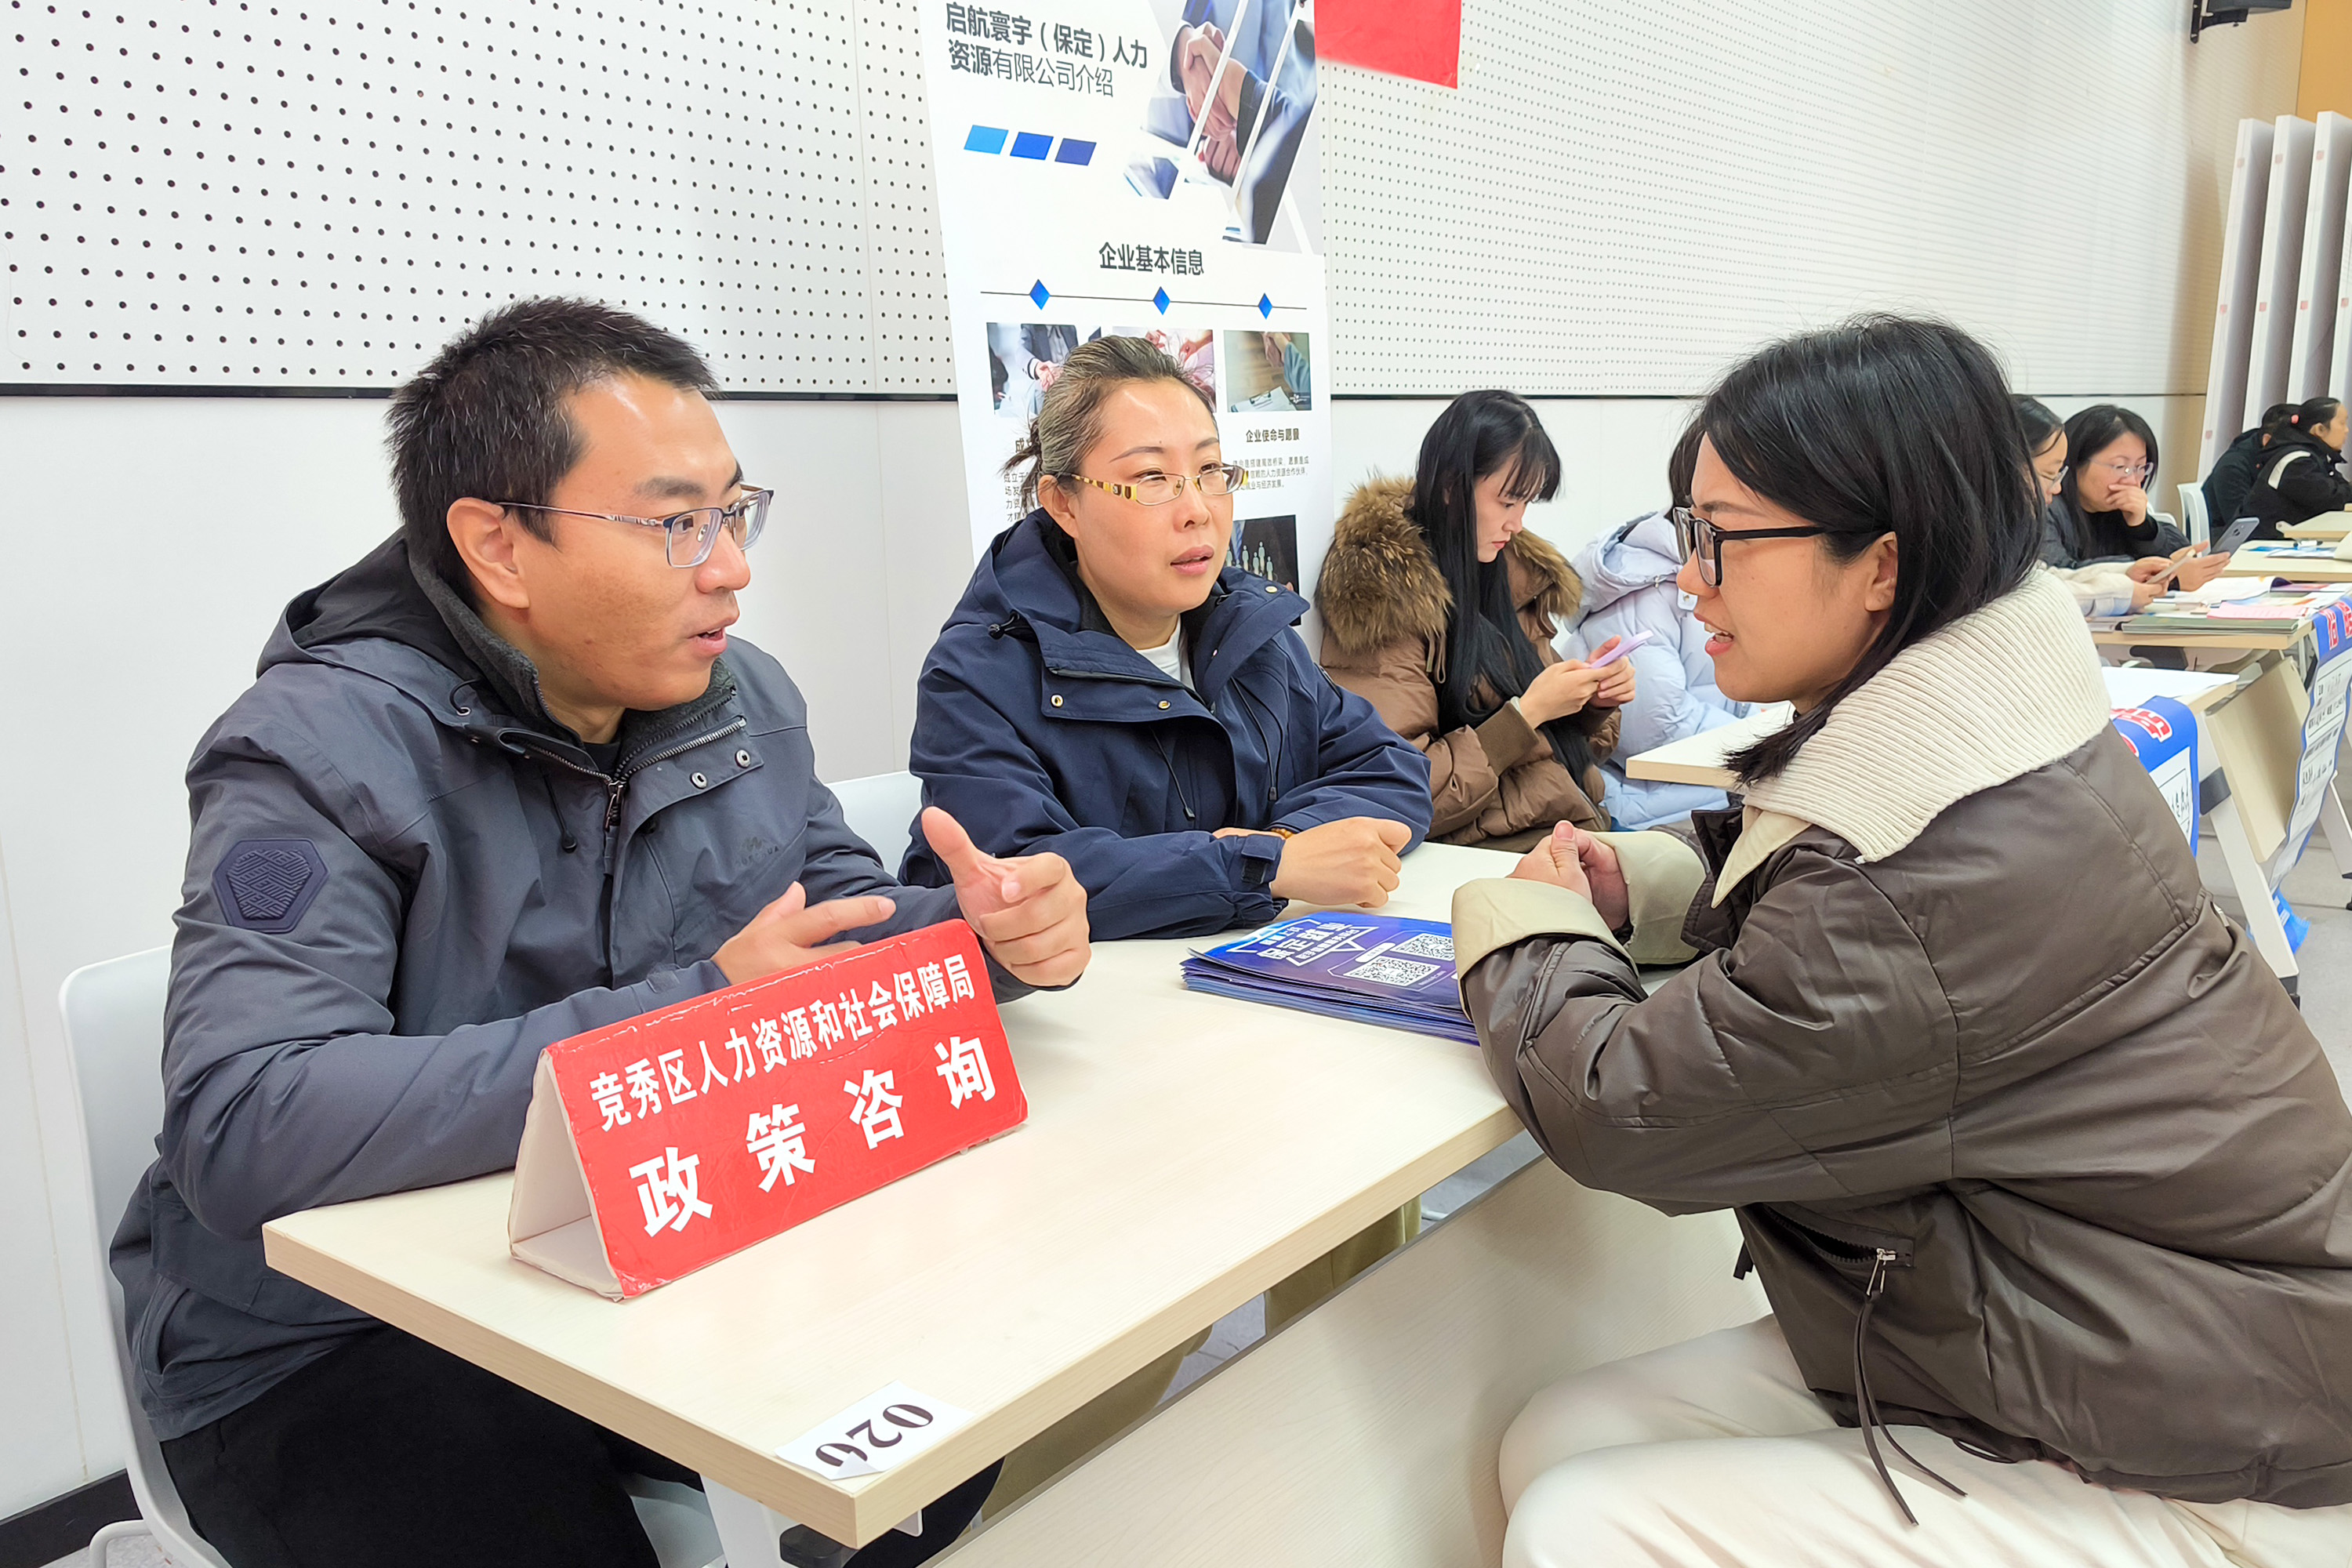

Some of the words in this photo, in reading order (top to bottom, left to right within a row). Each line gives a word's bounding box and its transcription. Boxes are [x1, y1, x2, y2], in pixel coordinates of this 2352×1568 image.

[946, 2, 1147, 69] 启航寰宇（保定）人力
[949, 39, 1113, 97] 资源有限公司介绍
[1099, 241, 1204, 275] 企业基本信息
[590, 954, 975, 1131] 竞秀区人力资源和社会保障局
[629, 1036, 996, 1237] 政策咨询
[815, 1403, 934, 1467] 020
